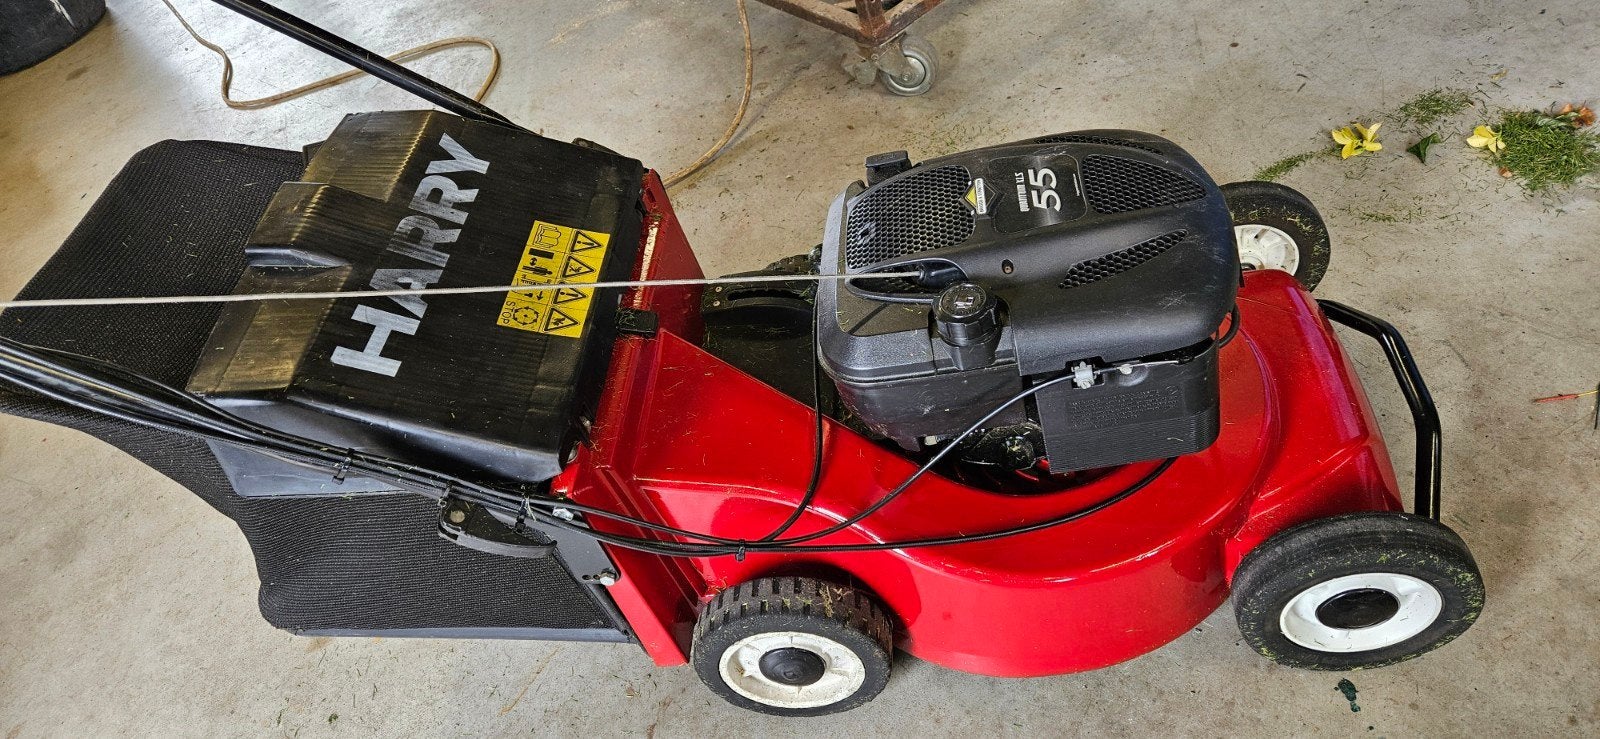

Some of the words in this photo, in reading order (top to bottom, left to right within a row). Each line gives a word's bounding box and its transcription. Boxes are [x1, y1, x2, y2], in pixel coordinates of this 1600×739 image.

[1028, 168, 1061, 212] 55
[330, 133, 490, 378] HARRY
[499, 300, 516, 325] STOP
